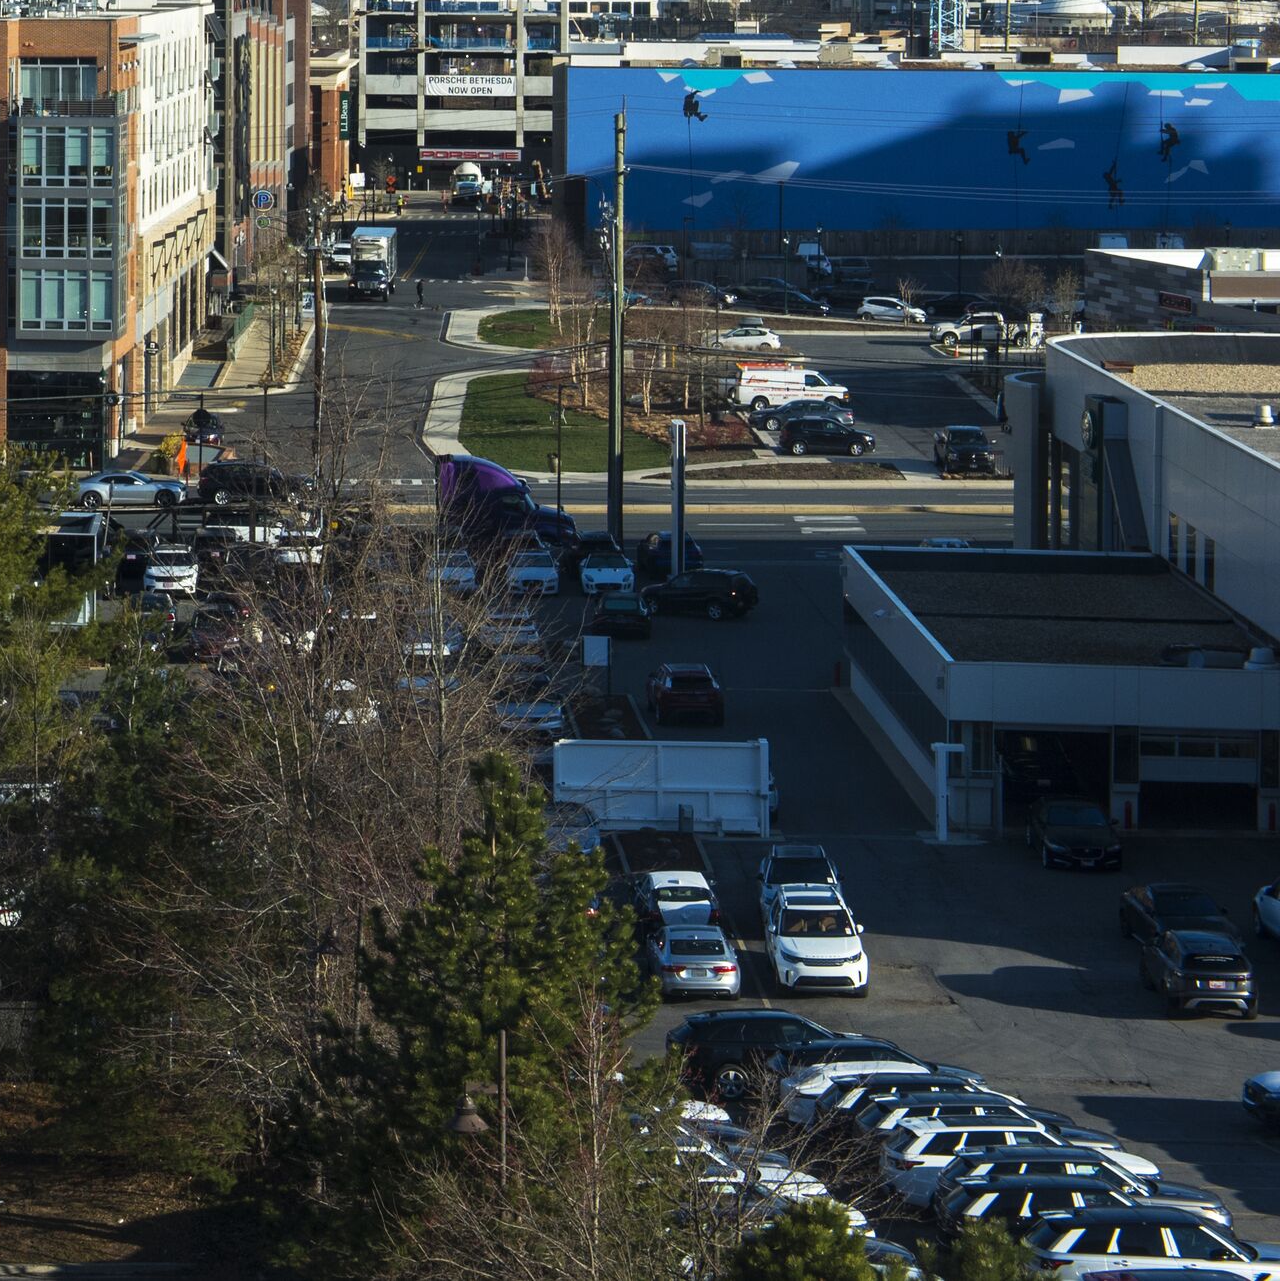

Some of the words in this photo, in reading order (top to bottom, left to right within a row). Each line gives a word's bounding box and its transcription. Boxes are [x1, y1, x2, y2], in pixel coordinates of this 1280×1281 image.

[429, 77, 467, 85] PORSCHE
[469, 77, 513, 85] BETHESDA
[448, 87, 468, 95] NOW
[470, 87, 493, 95] OPEN
[422, 151, 519, 160] PORSCHE
